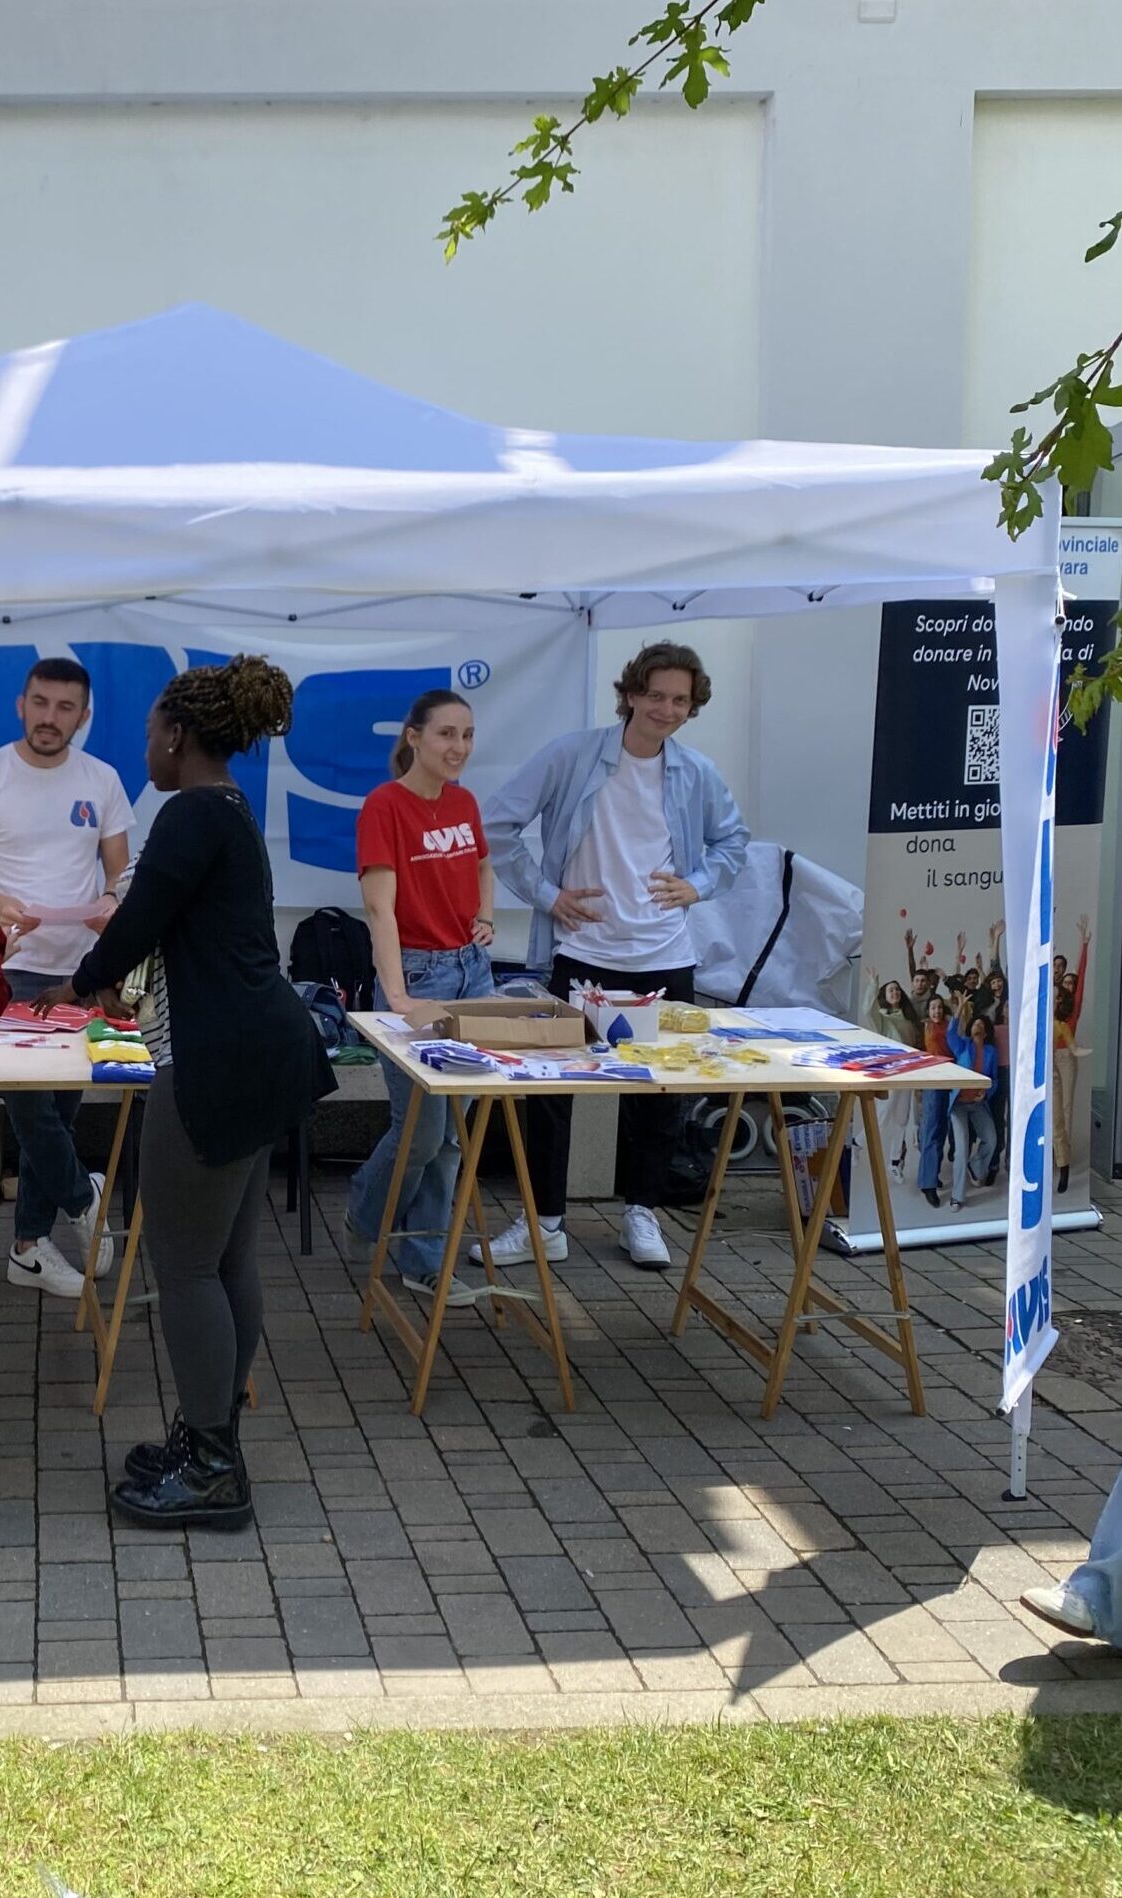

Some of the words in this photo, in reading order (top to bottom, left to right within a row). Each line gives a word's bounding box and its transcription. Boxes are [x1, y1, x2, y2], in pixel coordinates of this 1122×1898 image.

[1059, 535, 1119, 553] vinciale
[915, 615, 969, 637] Scopri
[972, 615, 996, 632] do
[1063, 615, 1094, 631] ndo
[912, 645, 973, 662] donare
[976, 644, 992, 661] in
[1077, 644, 1095, 660] di
[967, 674, 999, 691] Nov
[890, 801, 950, 820] Mettiti
[954, 799, 970, 818] in
[974, 798, 1001, 822] gio
[423, 822, 475, 852] AVIS
[906, 835, 956, 854] dona
[927, 869, 938, 887] il
[943, 870, 1004, 890] sangu
